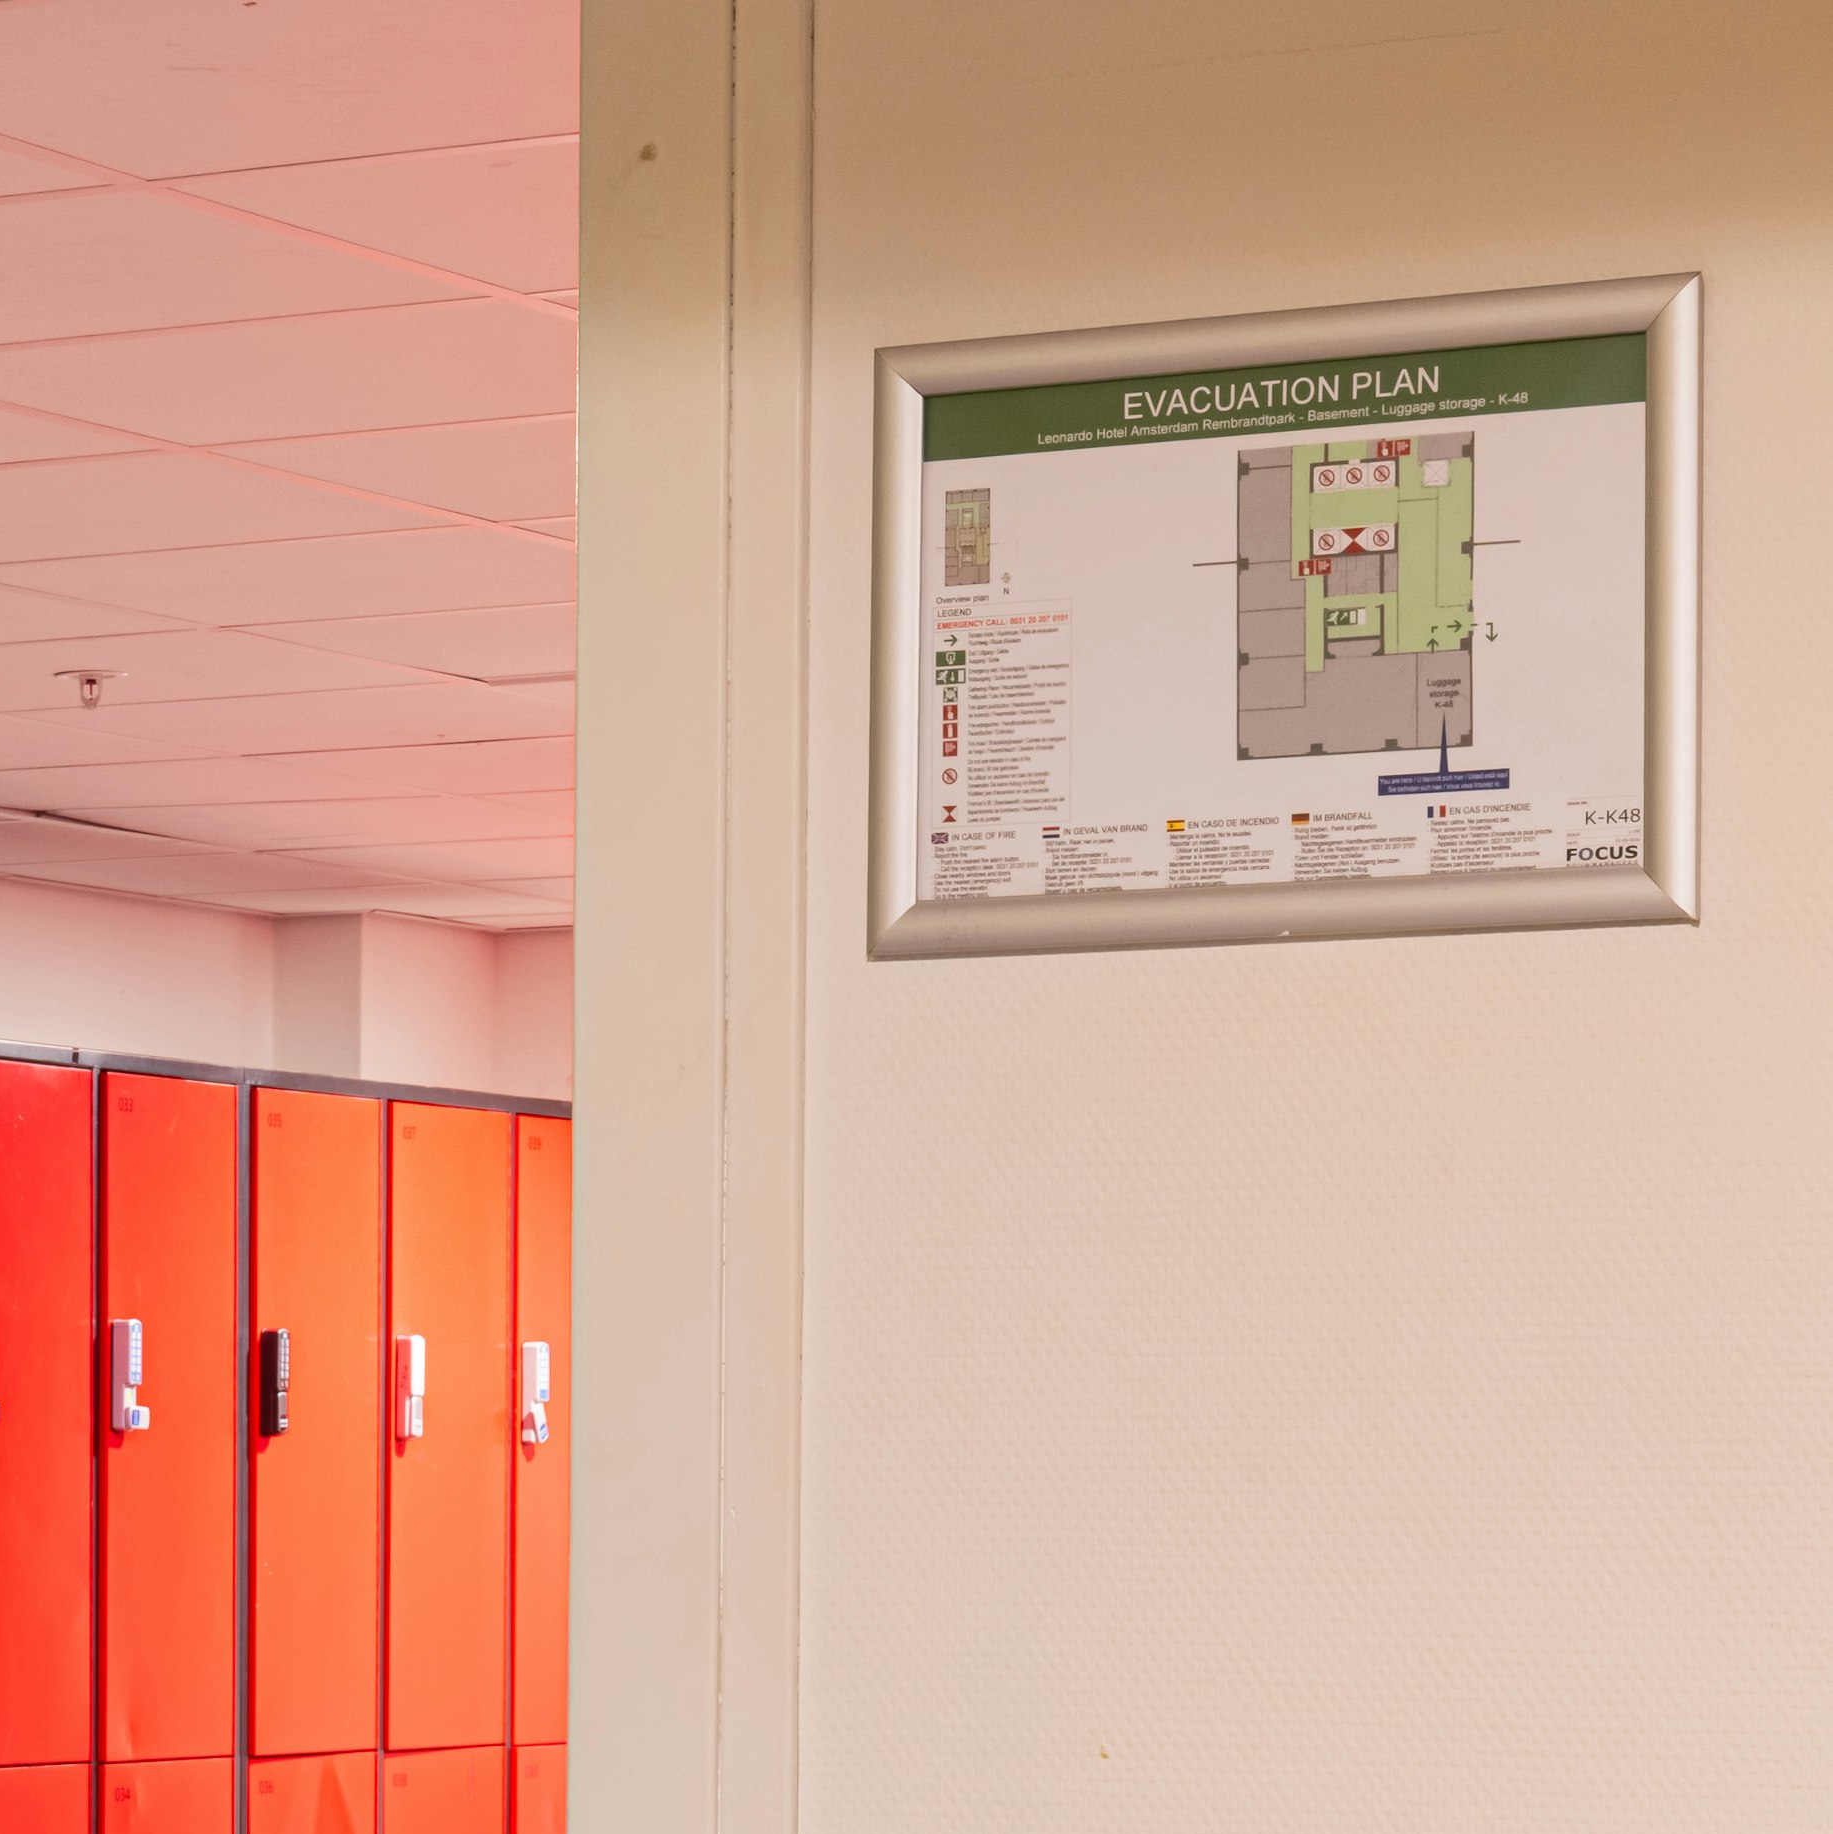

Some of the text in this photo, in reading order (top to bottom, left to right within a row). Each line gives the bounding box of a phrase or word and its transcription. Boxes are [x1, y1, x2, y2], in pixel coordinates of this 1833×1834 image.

[1124, 366, 1439, 419] EVACUATION PLAN
[1038, 430, 1093, 444] Leonardo
[1097, 426, 1127, 439] Hotel
[1130, 422, 1198, 436] Amsterdam
[1203, 412, 1295, 430] Rembrandtpark
[1308, 406, 1369, 421] Basement
[1382, 402, 1435, 417] Luggage
[1439, 398, 1486, 410] storage
[1499, 392, 1528, 405] K-48
[936, 594, 989, 604] Overview plan
[937, 608, 971, 617] LEGEND
[937, 620, 983, 630] EMERGENCY
[1010, 617, 1026, 625] 0031
[1028, 616, 1037, 624] 20
[1038, 615, 1050, 623] 207
[1427, 678, 1461, 688] Luggage
[1429, 689, 1459, 698] storage
[1435, 700, 1454, 709] K-48
[1464, 806, 1480, 814] CAS
[1325, 812, 1372, 821] BRANDFALL
[1585, 808, 1641, 825] K-K48
[1188, 817, 1279, 829] EN CASO DE INCENDIO
[1073, 827, 1098, 835] GEVAL
[1121, 824, 1148, 832] BRAND
[952, 831, 1016, 842] IN CASE OF FIRE
[1566, 845, 1638, 861] FOCUS
[117, 1097, 133, 1112] 033
[114, 1788, 131, 1802] 034
